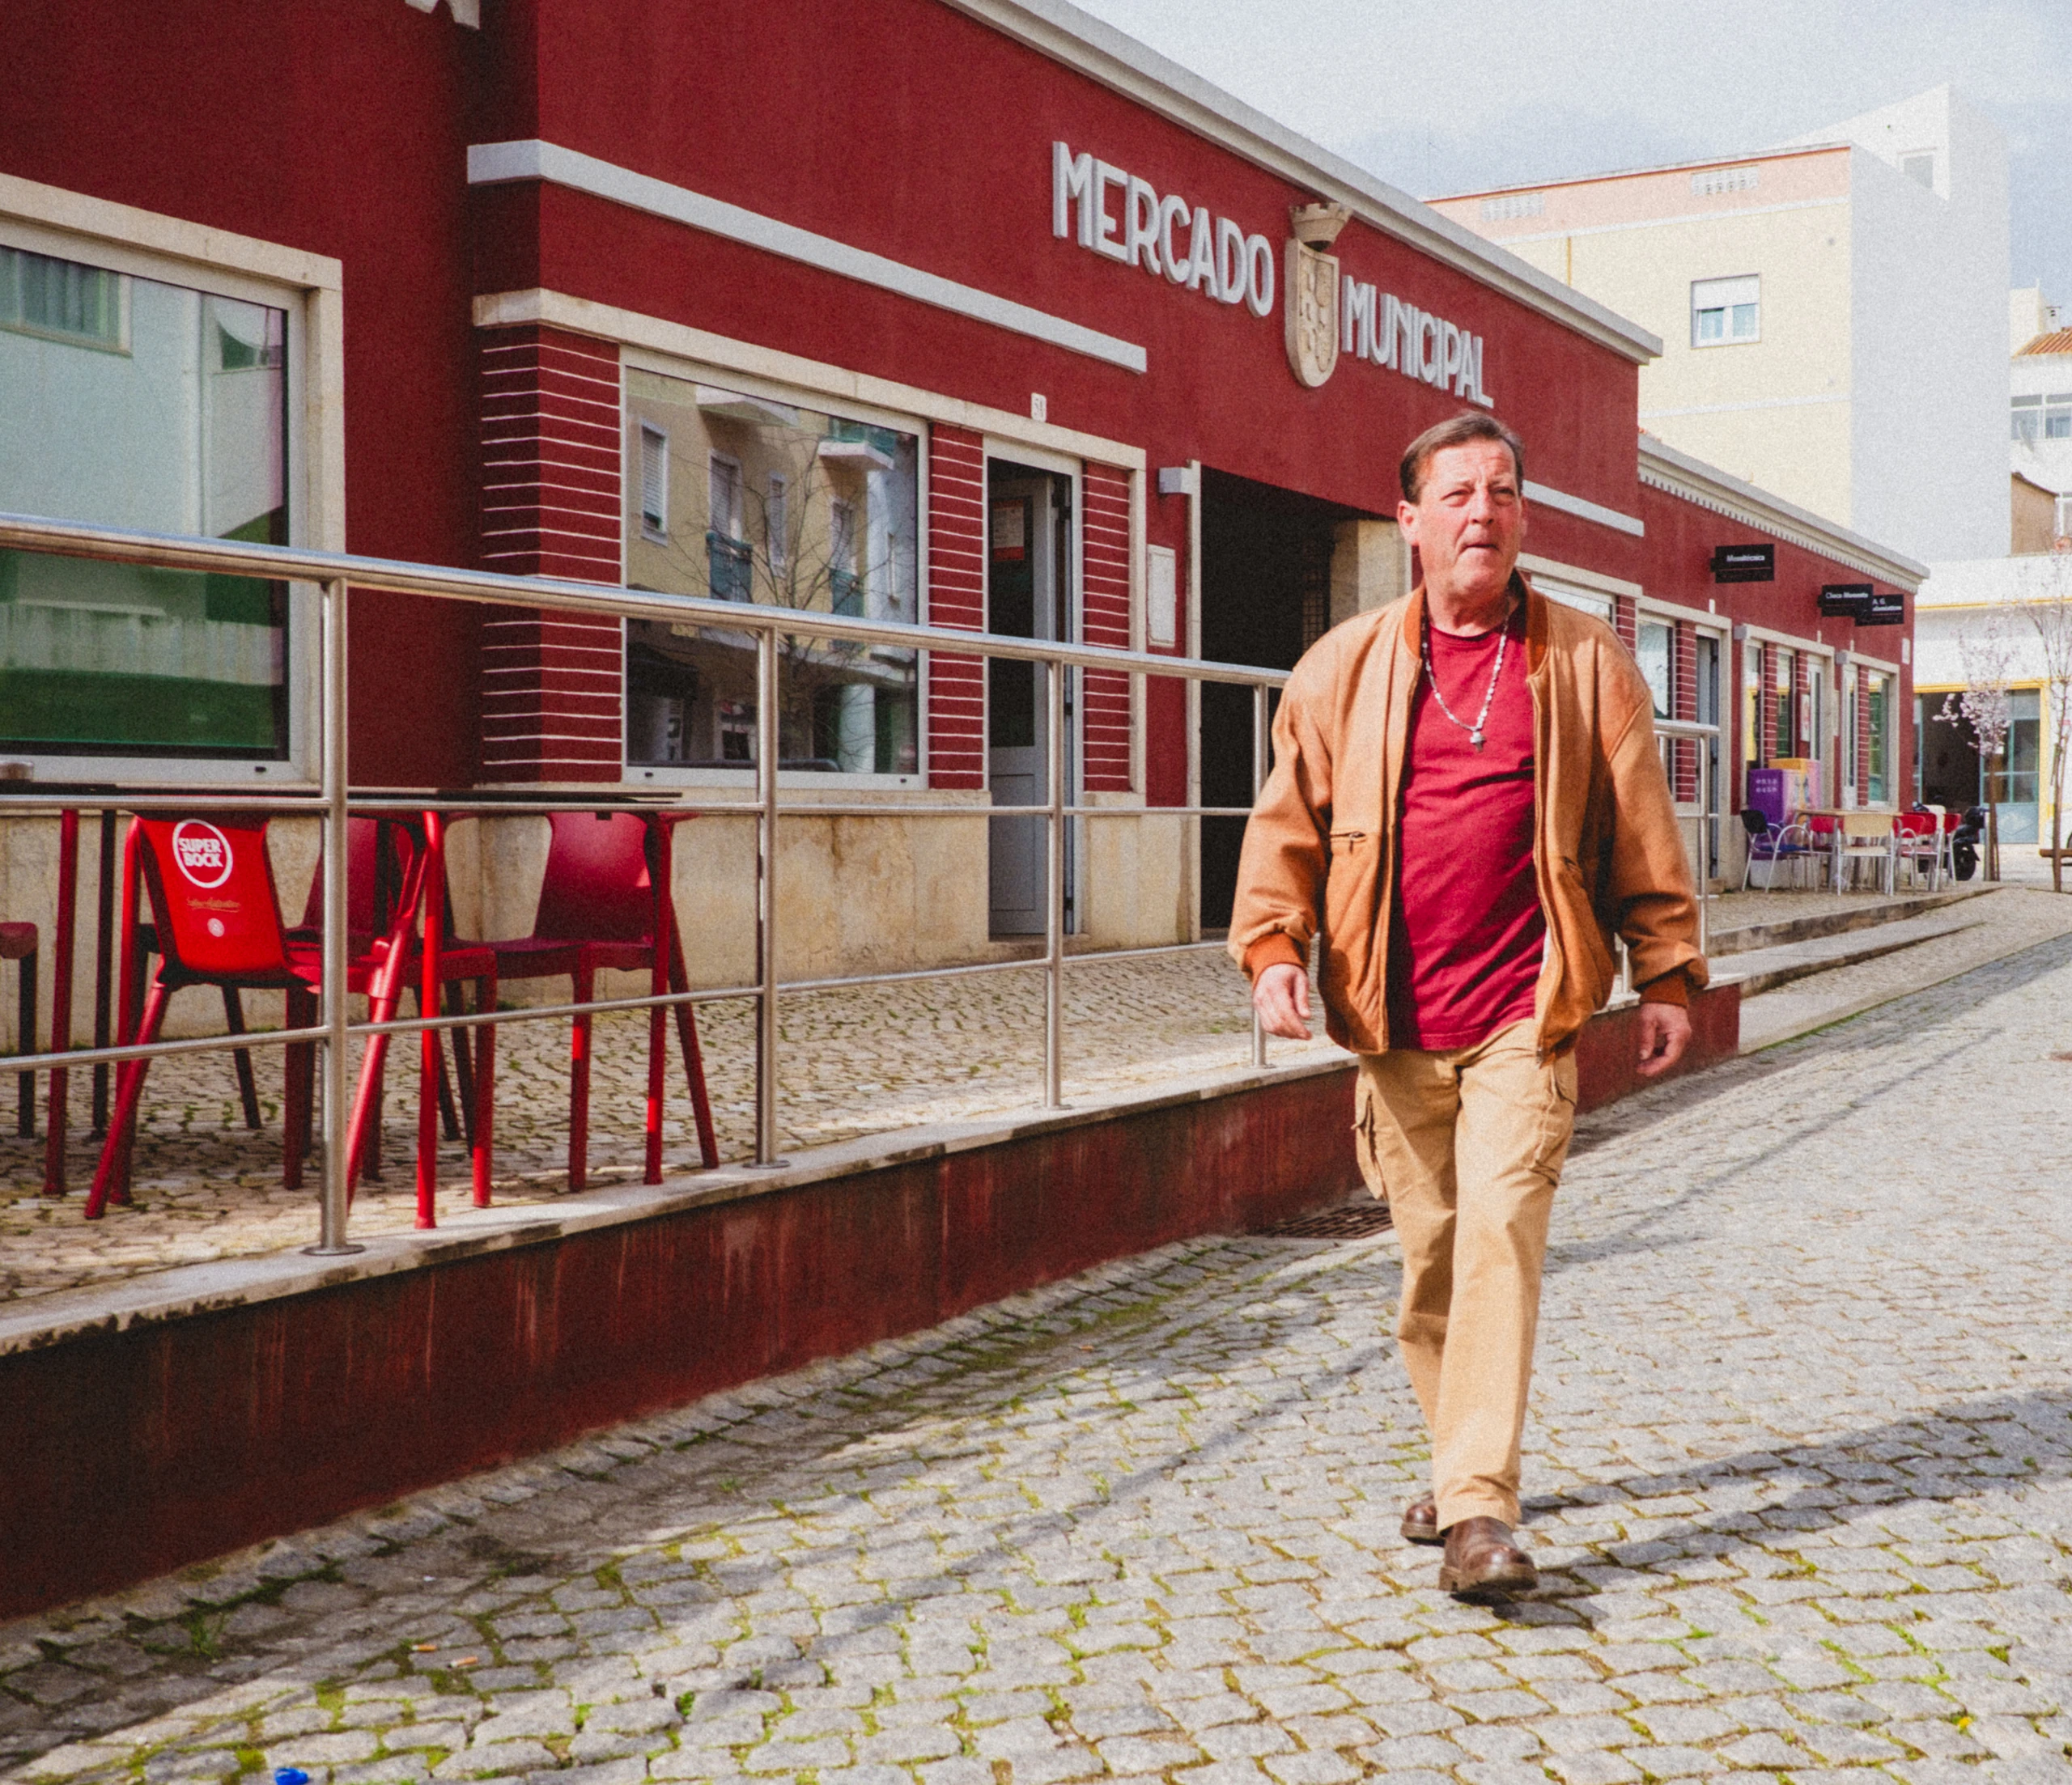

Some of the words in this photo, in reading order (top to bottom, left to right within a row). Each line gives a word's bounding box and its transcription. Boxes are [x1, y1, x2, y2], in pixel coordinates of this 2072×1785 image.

[1052, 141, 1275, 318] MERCADO
[1341, 274, 1494, 409] MUNICIPAL
[179, 838, 222, 853] SUPER
[184, 854, 223, 867] BOCK
